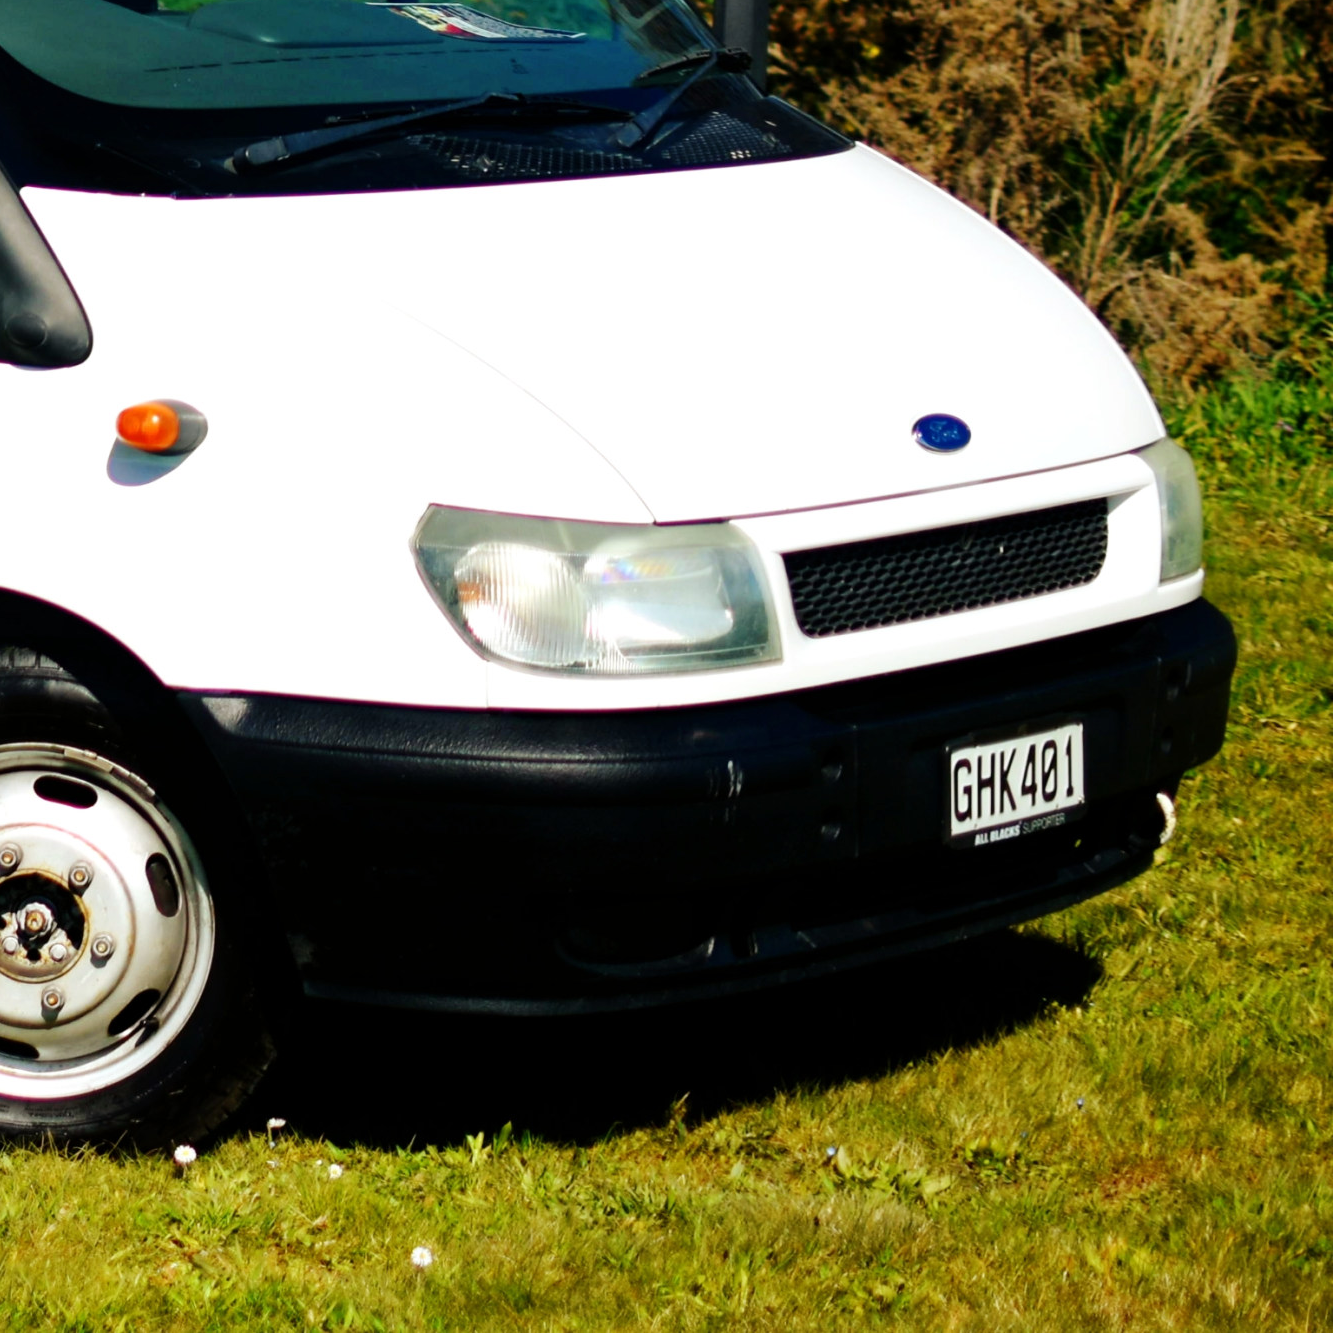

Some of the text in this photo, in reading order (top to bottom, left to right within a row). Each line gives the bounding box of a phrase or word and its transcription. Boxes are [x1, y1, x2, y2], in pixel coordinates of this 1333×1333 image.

[953, 734, 1074, 823] GHK401
[974, 832, 989, 846] ALL
[1022, 813, 1066, 834] SUPPORTER
